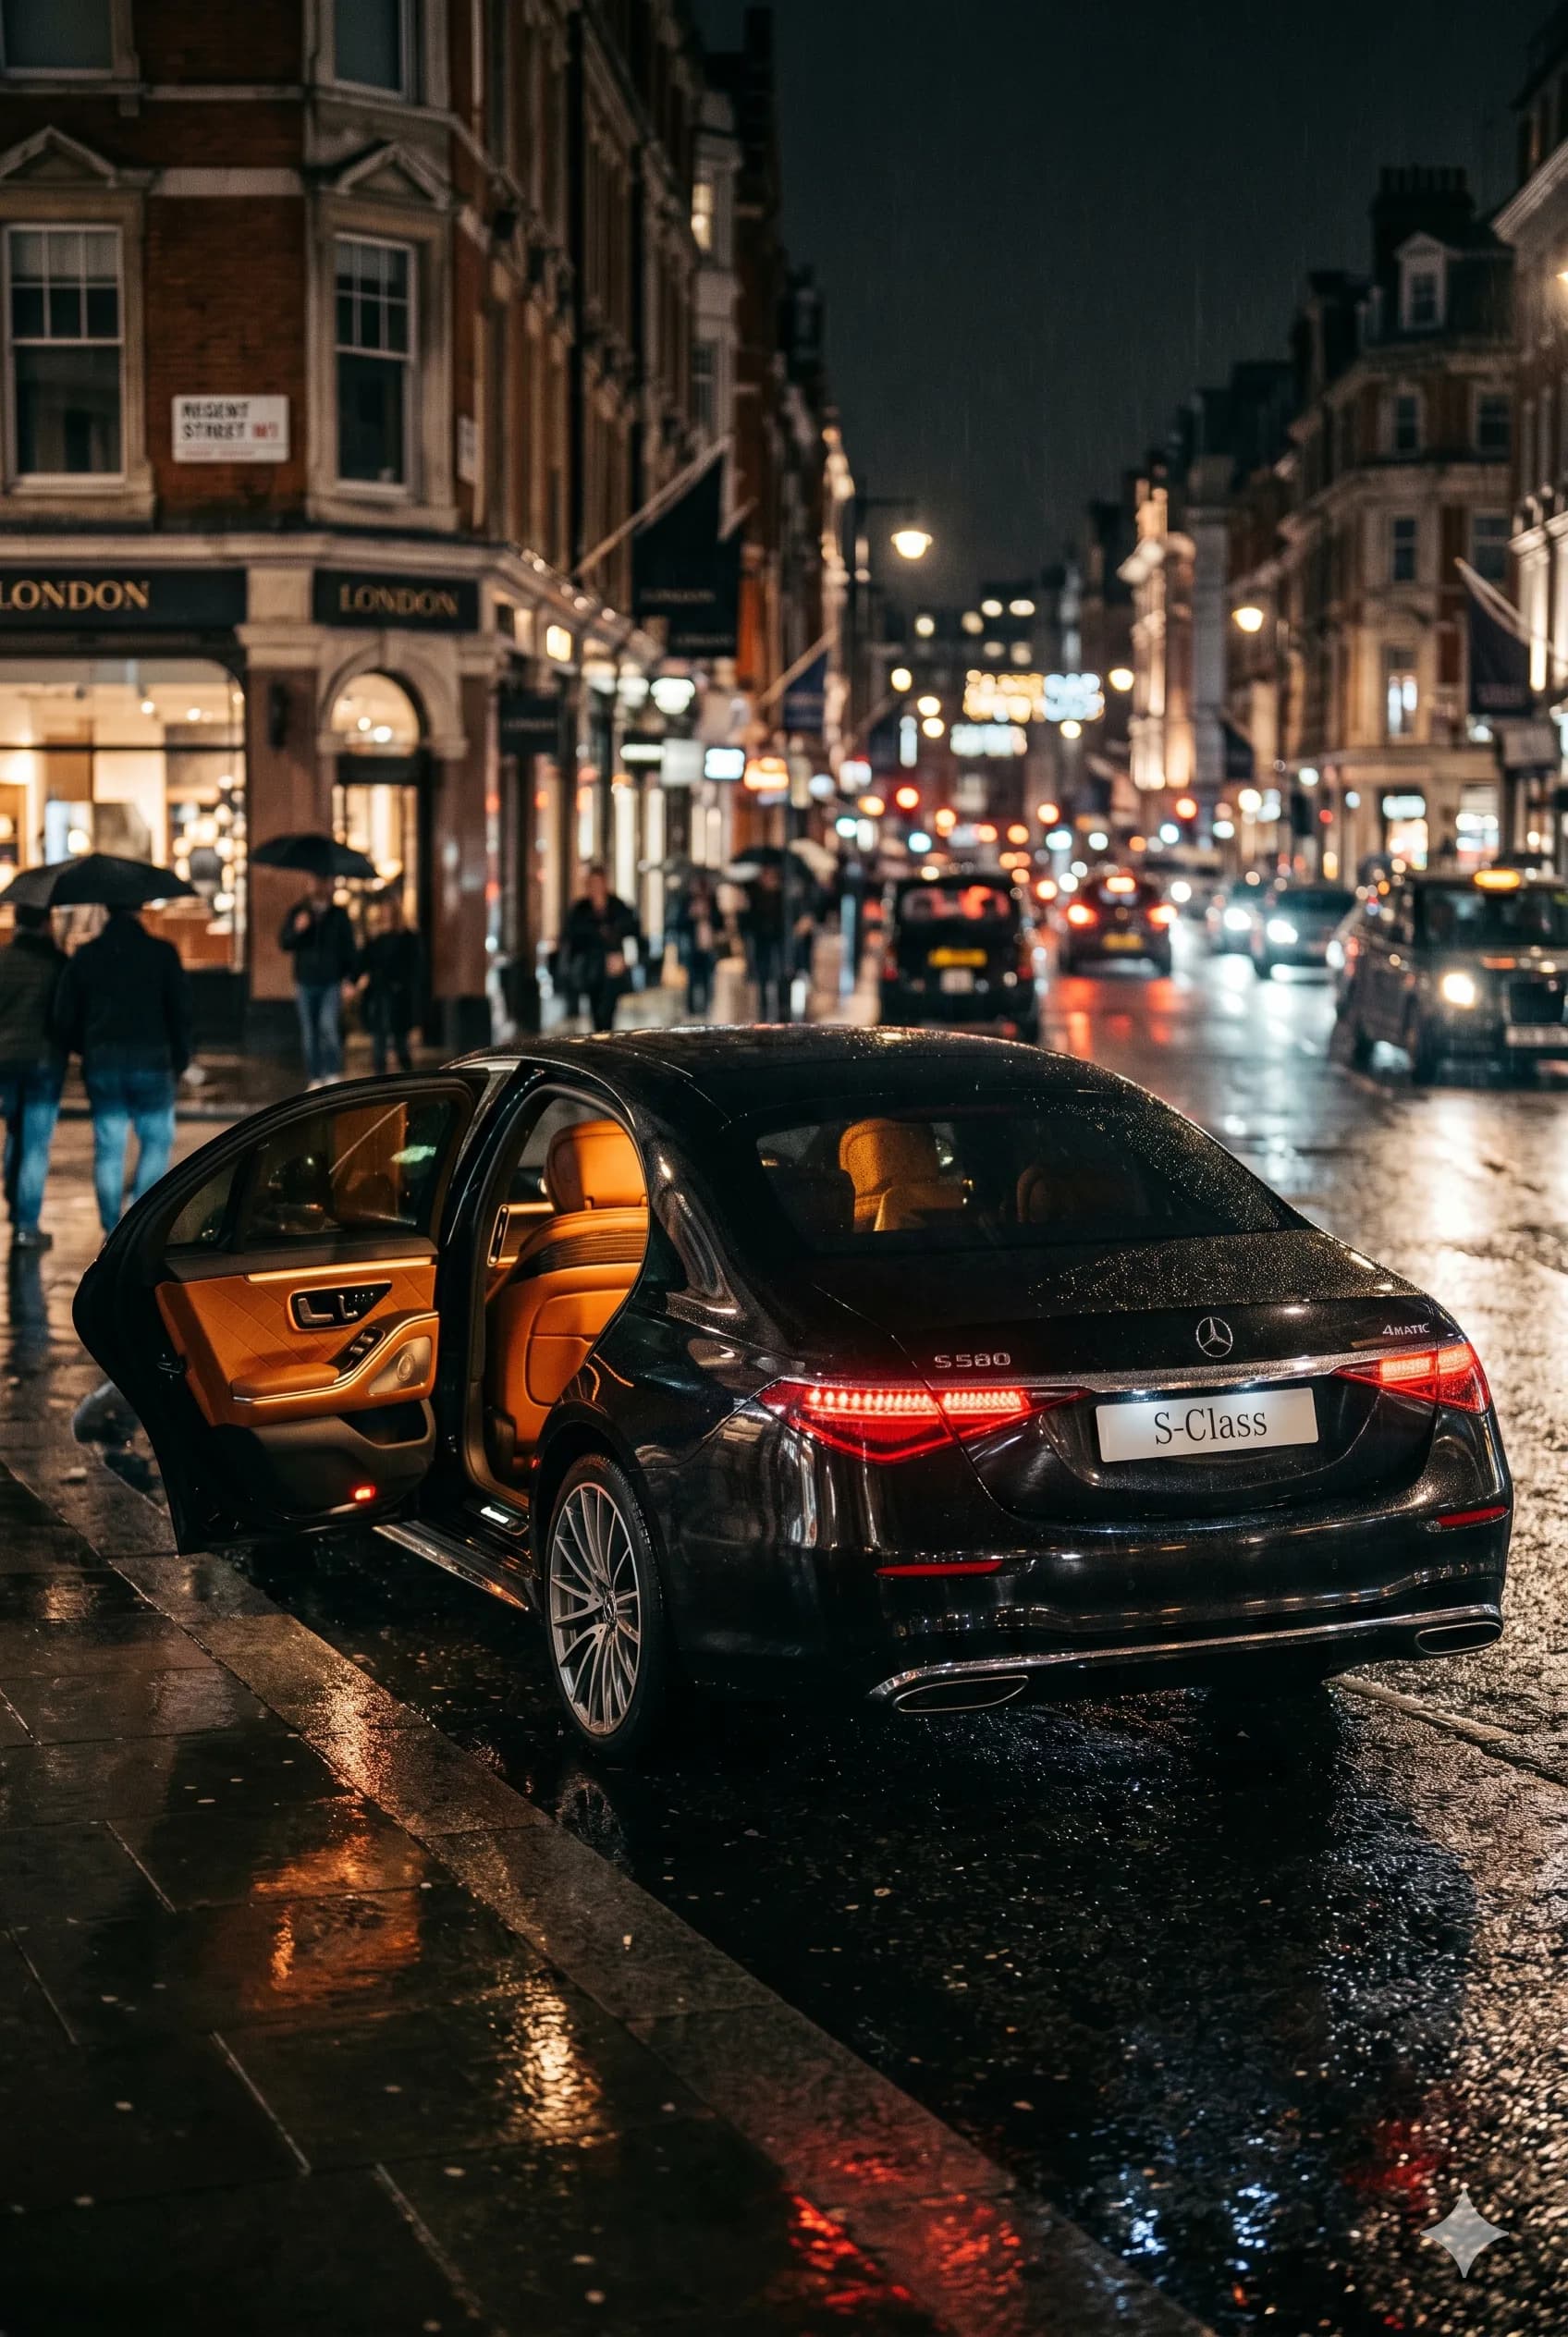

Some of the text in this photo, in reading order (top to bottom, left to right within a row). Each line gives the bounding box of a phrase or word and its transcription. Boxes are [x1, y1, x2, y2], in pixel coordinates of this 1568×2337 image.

[182, 401, 250, 419] REGENT
[183, 422, 246, 440] STREET
[339, 583, 459, 618] LONDON
[1154, 1407, 1268, 1445] S-Class
